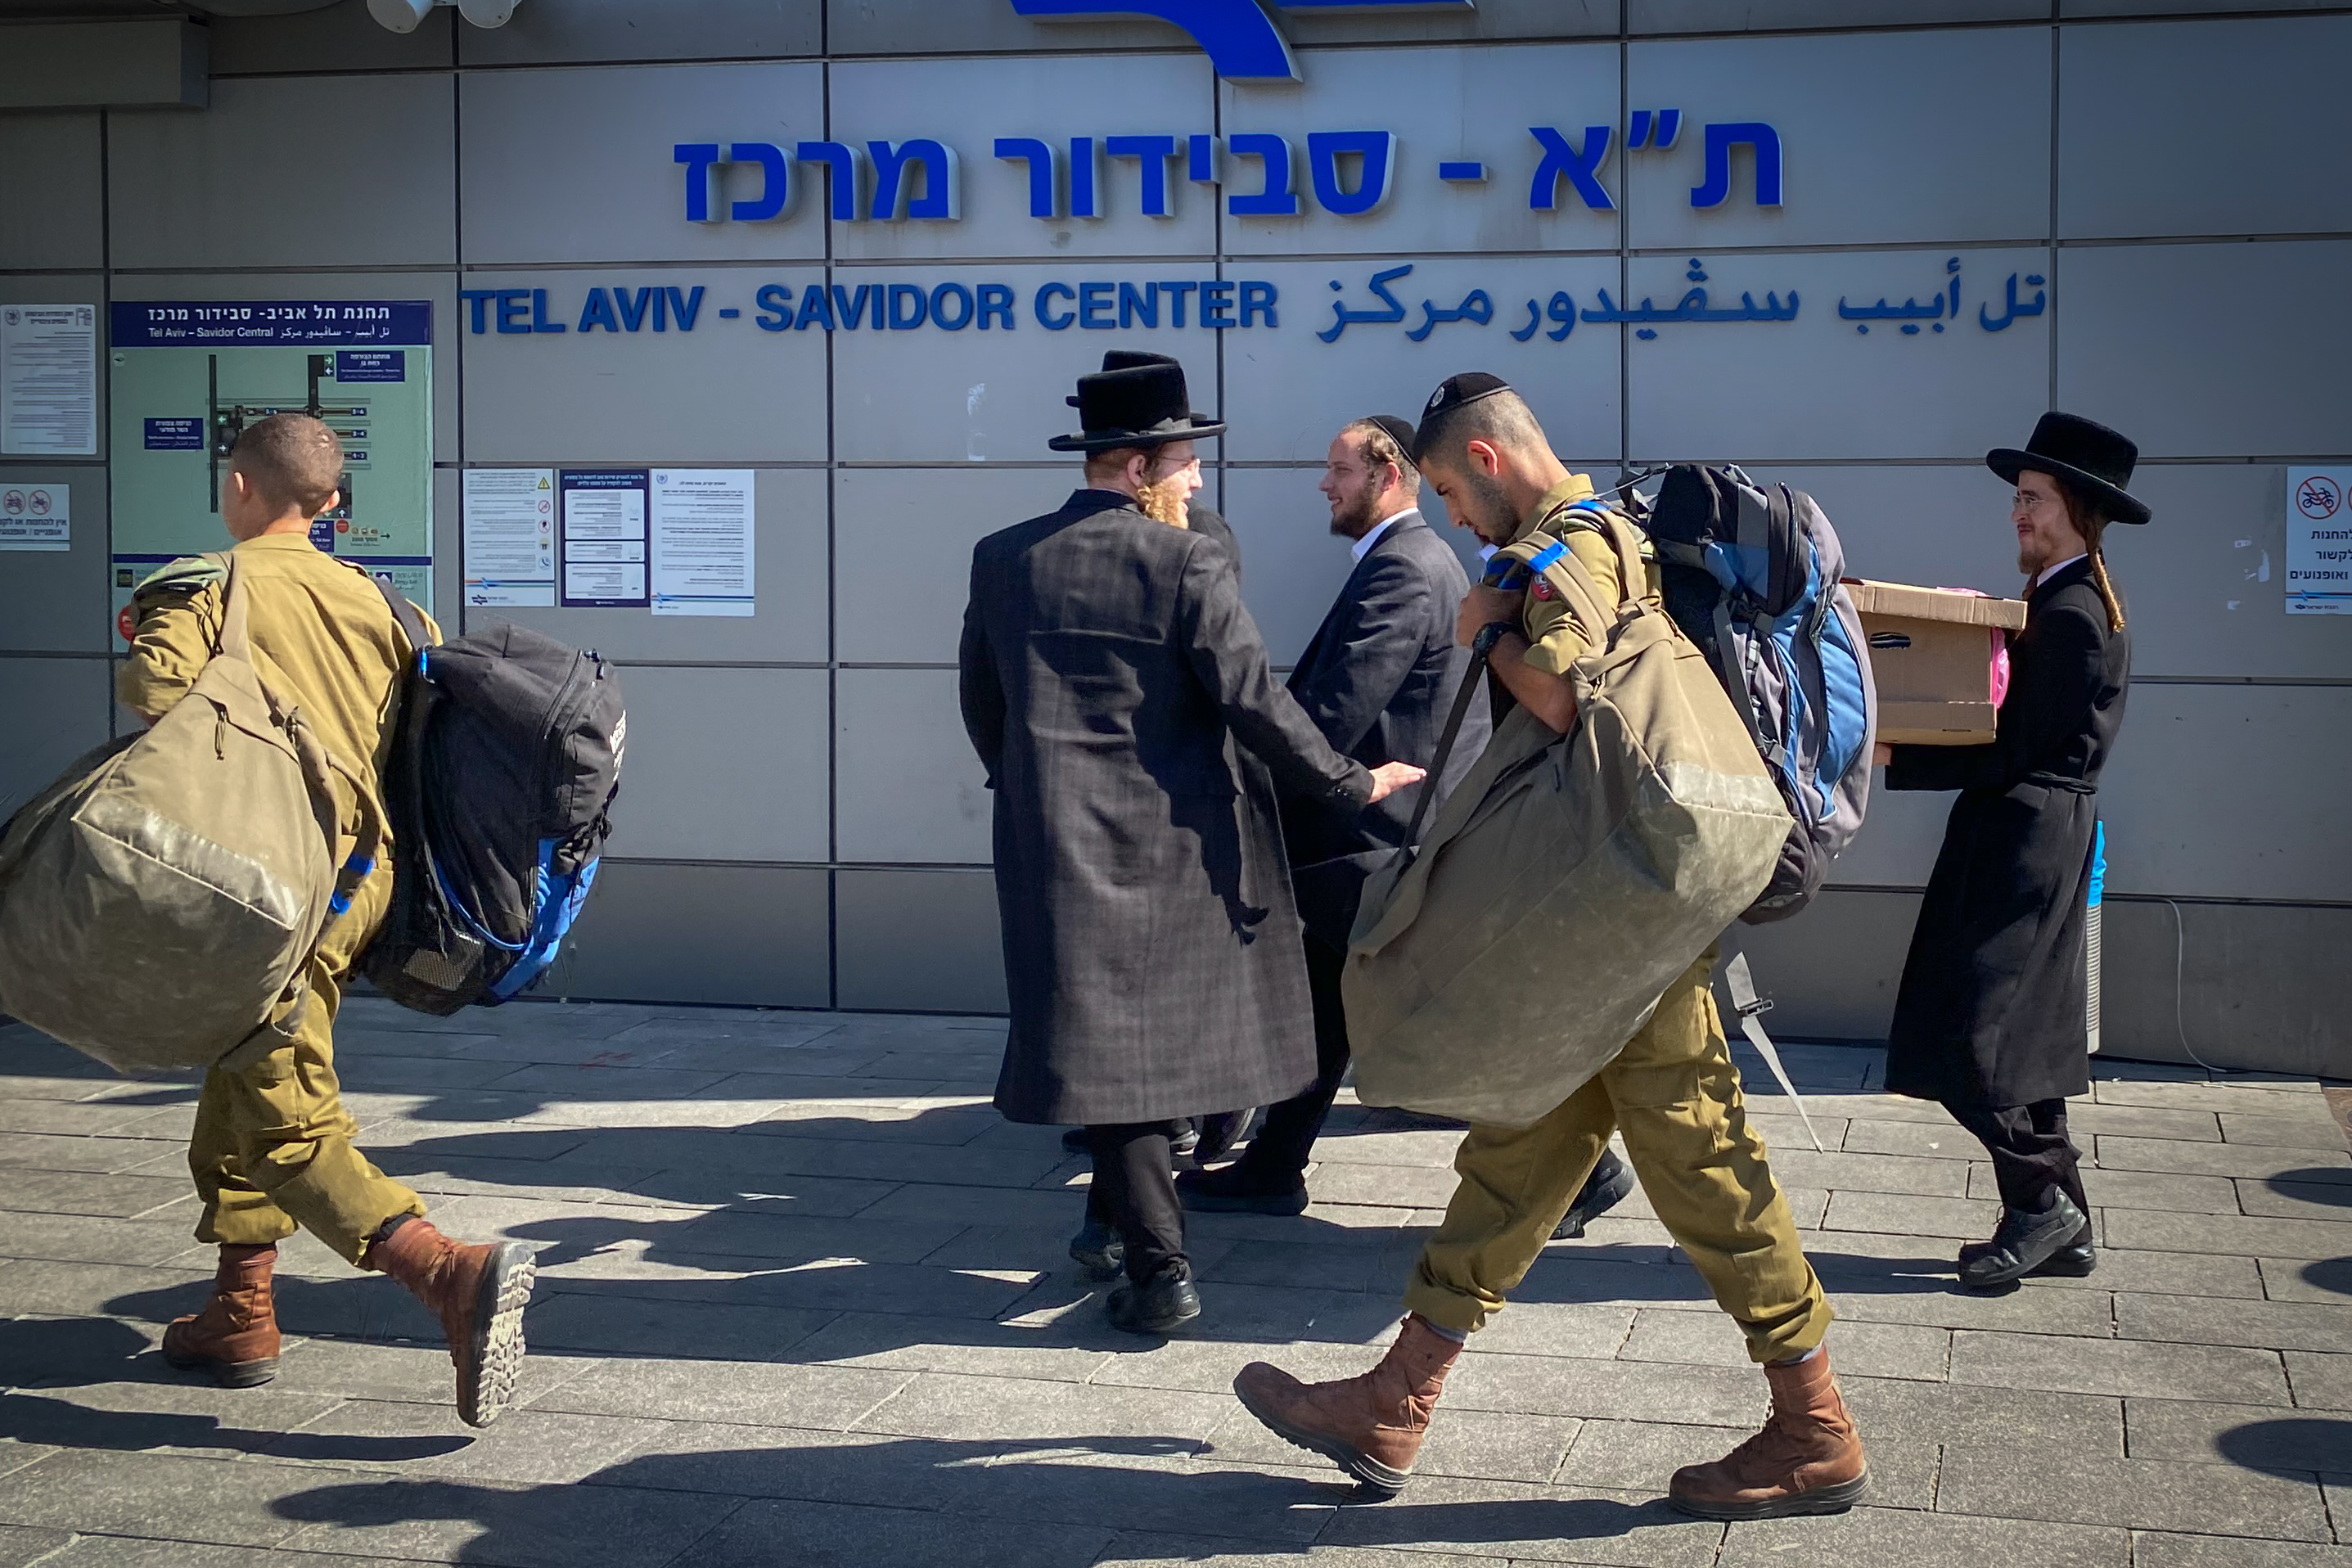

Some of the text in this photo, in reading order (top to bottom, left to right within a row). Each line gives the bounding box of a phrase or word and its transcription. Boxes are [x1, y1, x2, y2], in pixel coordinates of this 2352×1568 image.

[674, 137, 959, 223] מרכז
[994, 131, 1395, 219] סבידור
[1440, 162, 1485, 182] -
[1315, 264, 1494, 344] مركز
[1837, 258, 1962, 336] أبيب
[1979, 272, 2047, 332] تل
[147, 309, 188, 321] מרכז
[195, 308, 251, 321] סבידור
[313, 304, 336, 320] תל
[343, 307, 390, 320] תחנת
[459, 280, 1278, 334] TEL AVIV - SAVIDOR CENTER
[148, 327, 163, 337] Tel
[165, 327, 187, 337] Aviv
[196, 327, 235, 337] Savidor
[237, 327, 274, 337] Central
[279, 327, 302, 339] مركز
[379, 327, 390, 338] تل
[2290, 570, 2349, 580] ואופנועים
